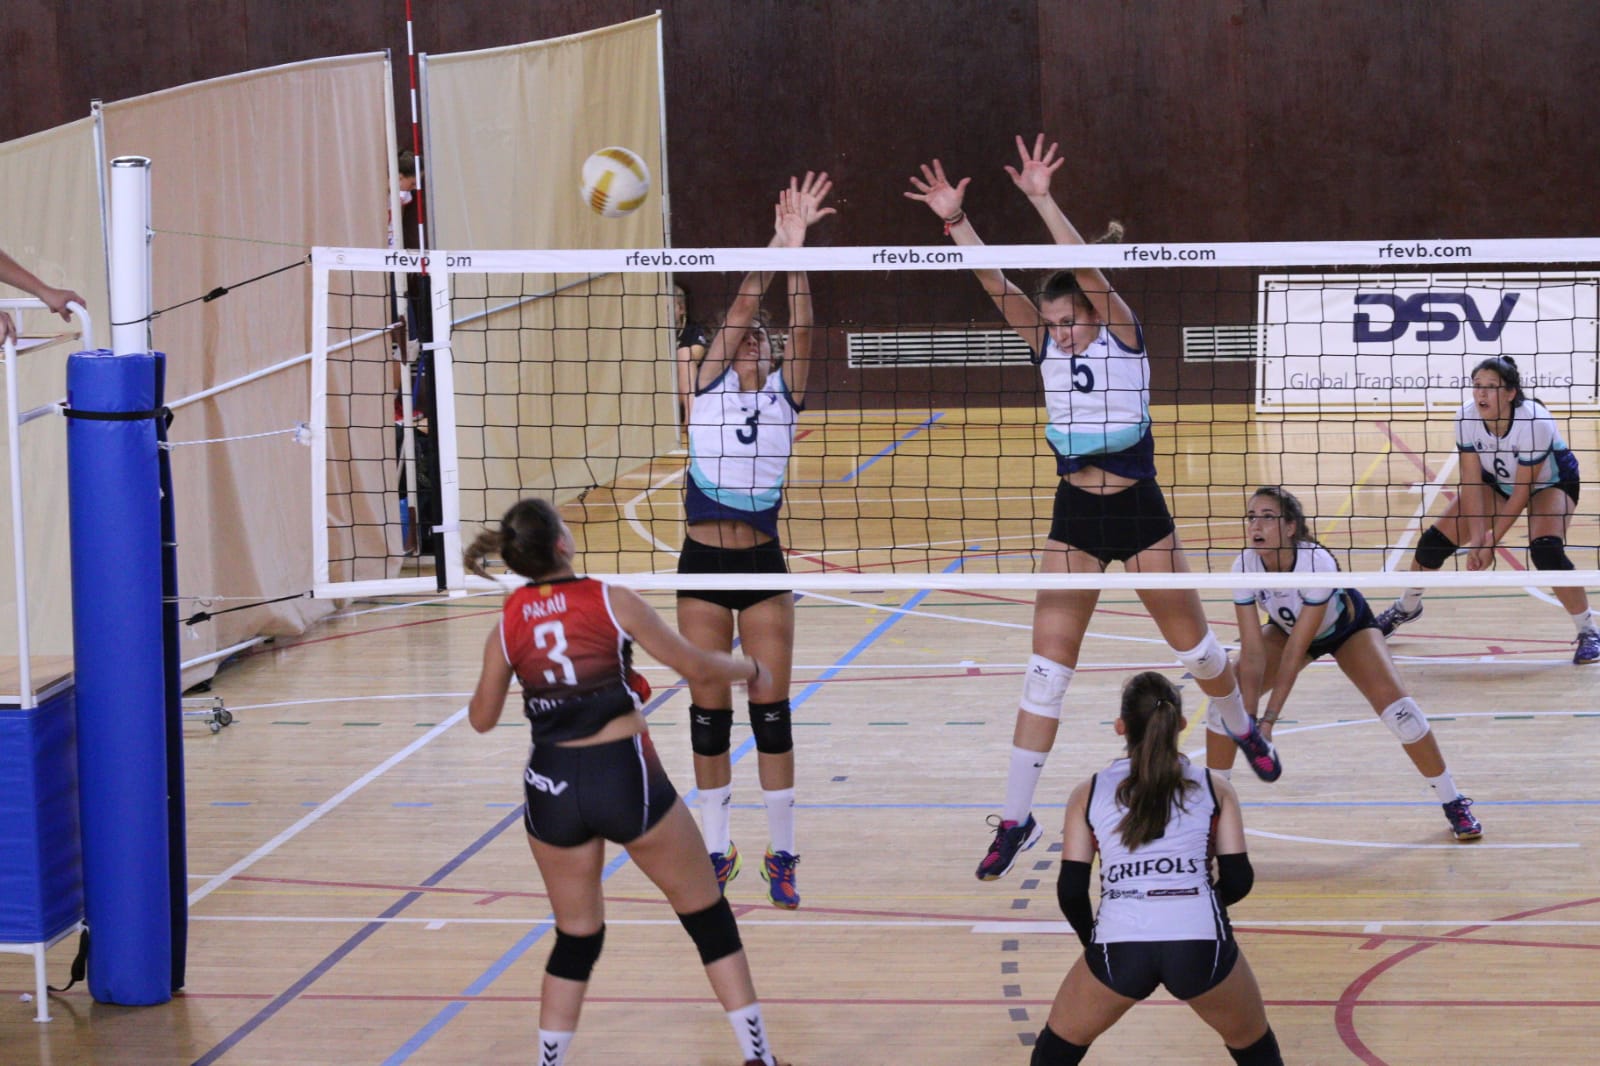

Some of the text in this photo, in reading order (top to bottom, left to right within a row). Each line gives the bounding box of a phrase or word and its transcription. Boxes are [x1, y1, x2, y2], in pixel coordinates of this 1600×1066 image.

[626, 251, 715, 266] rfevb.com
[872, 248, 964, 264] rfevb.com
[1123, 245, 1216, 261] rfevb.com
[1378, 242, 1472, 258] rfevb.com
[1352, 292, 1521, 343] DSV
[1070, 354, 1095, 394] 5
[1290, 371, 1348, 389] Global
[1355, 371, 1444, 393] Transport
[1450, 374, 1471, 388] an
[736, 407, 760, 445] 3
[1493, 457, 1510, 478] 6
[1278, 606, 1297, 627] 9
[532, 619, 578, 686] 3
[1107, 857, 1198, 883] GRIFOLS
